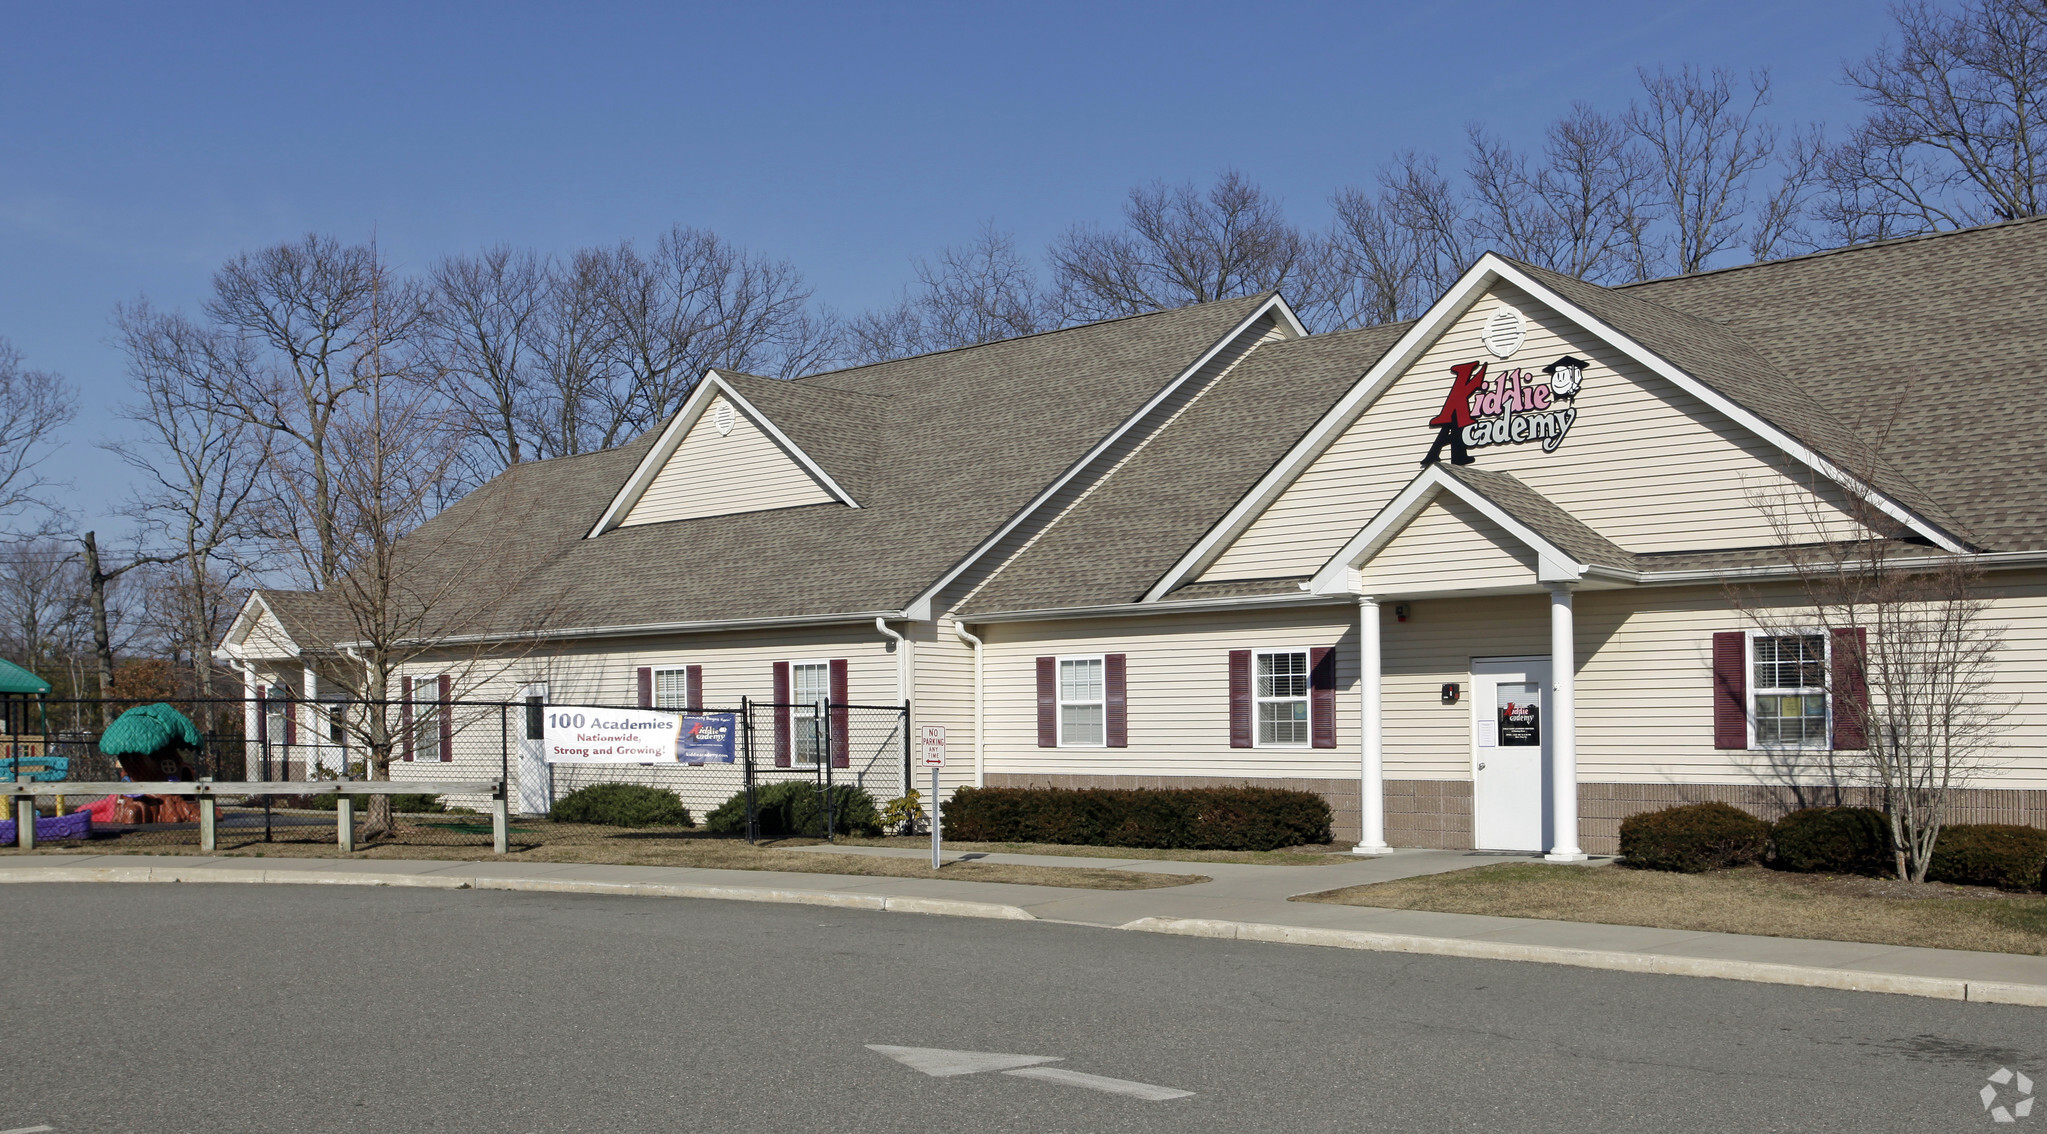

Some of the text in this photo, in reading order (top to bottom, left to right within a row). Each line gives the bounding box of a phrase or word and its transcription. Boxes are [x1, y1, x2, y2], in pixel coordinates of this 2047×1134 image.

[1429, 360, 1550, 428] Kiddie
[1420, 399, 1577, 466] Academy
[1504, 702, 1529, 716] Kiddie
[549, 713, 673, 730] 100 Academies
[1508, 713, 1535, 725] cademy
[688, 722, 719, 735] Kiddie
[577, 733, 641, 743] Nationwide,
[923, 738, 944, 746] PARKING
[554, 746, 666, 757] Strong and Growing!
